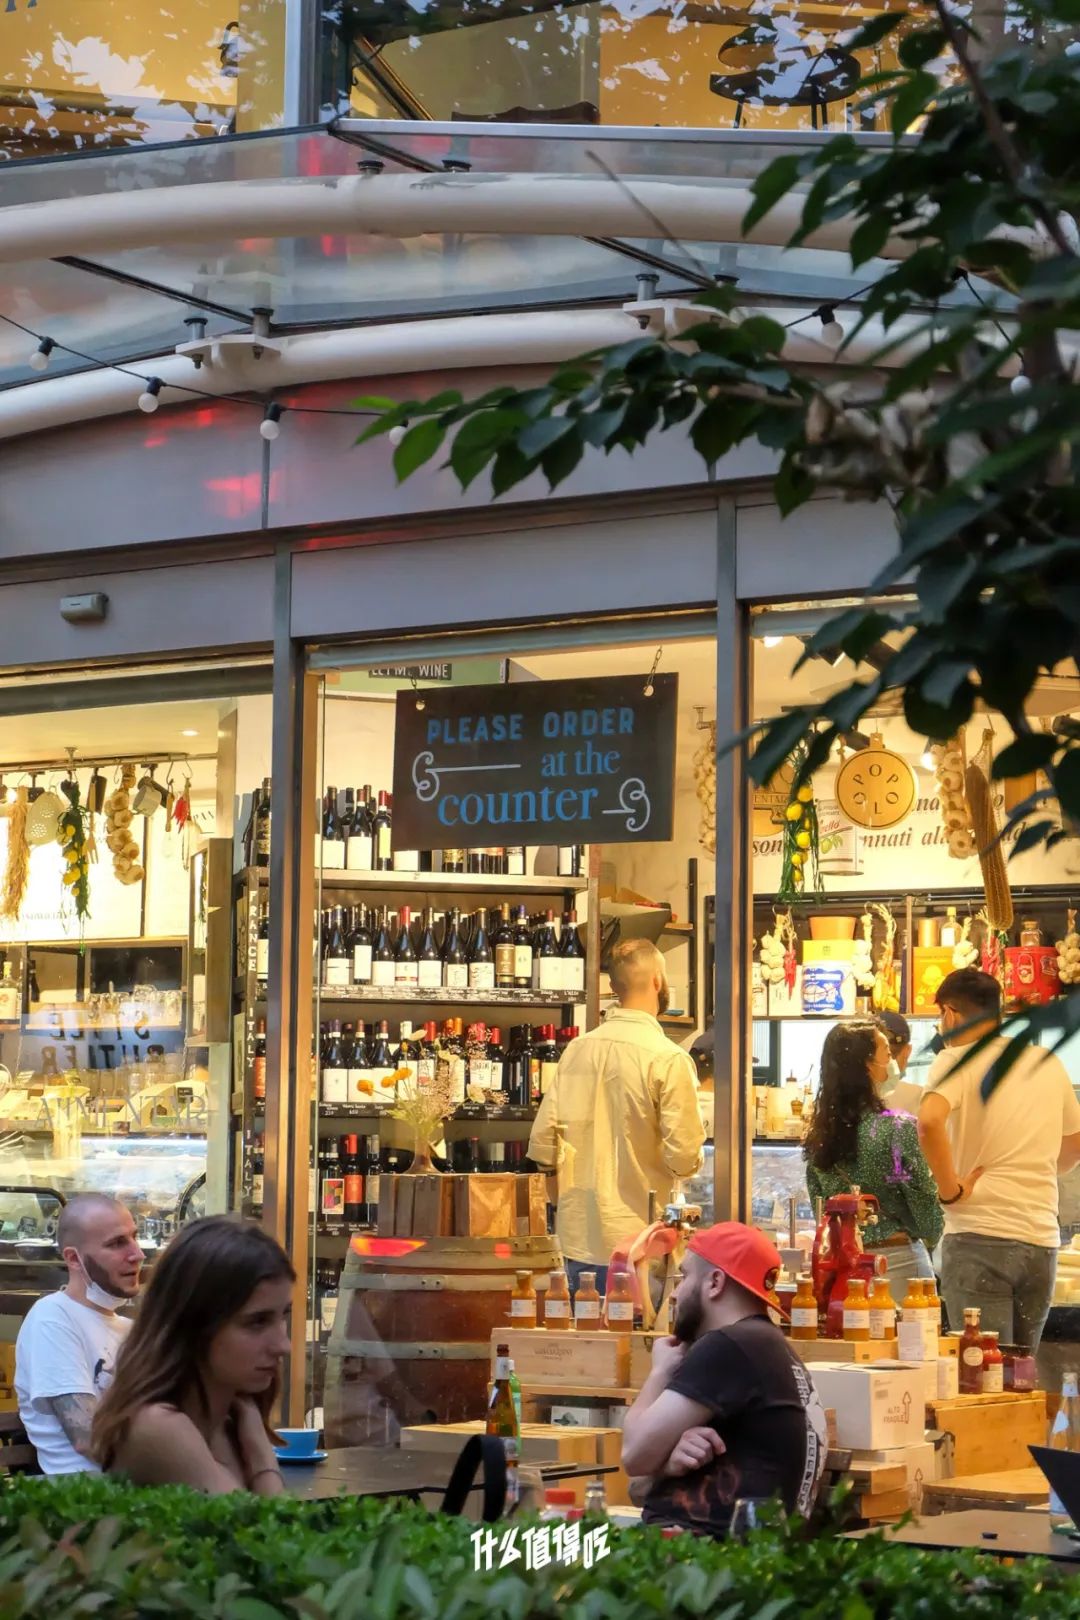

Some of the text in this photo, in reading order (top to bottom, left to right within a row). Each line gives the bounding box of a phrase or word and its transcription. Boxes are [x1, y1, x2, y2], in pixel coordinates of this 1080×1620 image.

[419, 664, 449, 679] WINE
[427, 707, 635, 744] PLEASE ORDER
[541, 741, 621, 777] at the
[437, 786, 599, 826] counter
[247, 890, 258, 972] FRANCE
[246, 1007, 256, 1068] ITALY
[243, 1129, 253, 1197] ITALY
